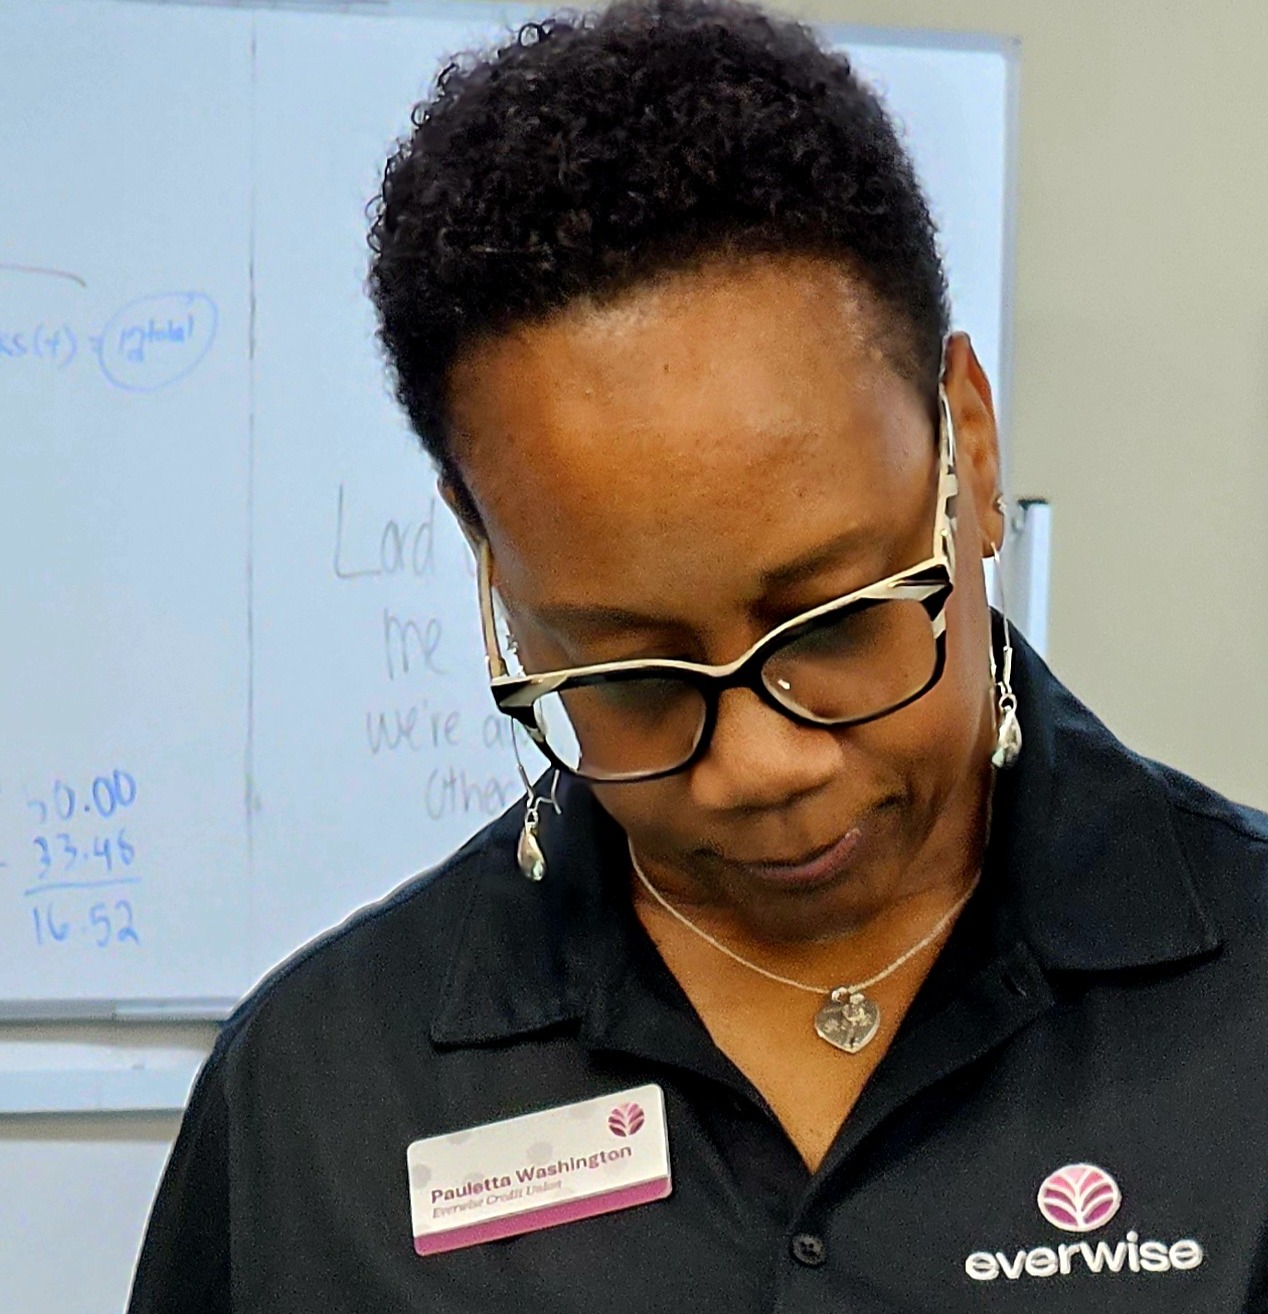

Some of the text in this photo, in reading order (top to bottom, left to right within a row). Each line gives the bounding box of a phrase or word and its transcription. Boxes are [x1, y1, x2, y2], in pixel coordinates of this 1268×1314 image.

[333, 483, 436, 579] Lord
[430, 1145, 632, 1204] Pauletta Washington
[965, 1230, 1203, 1281] everwise
